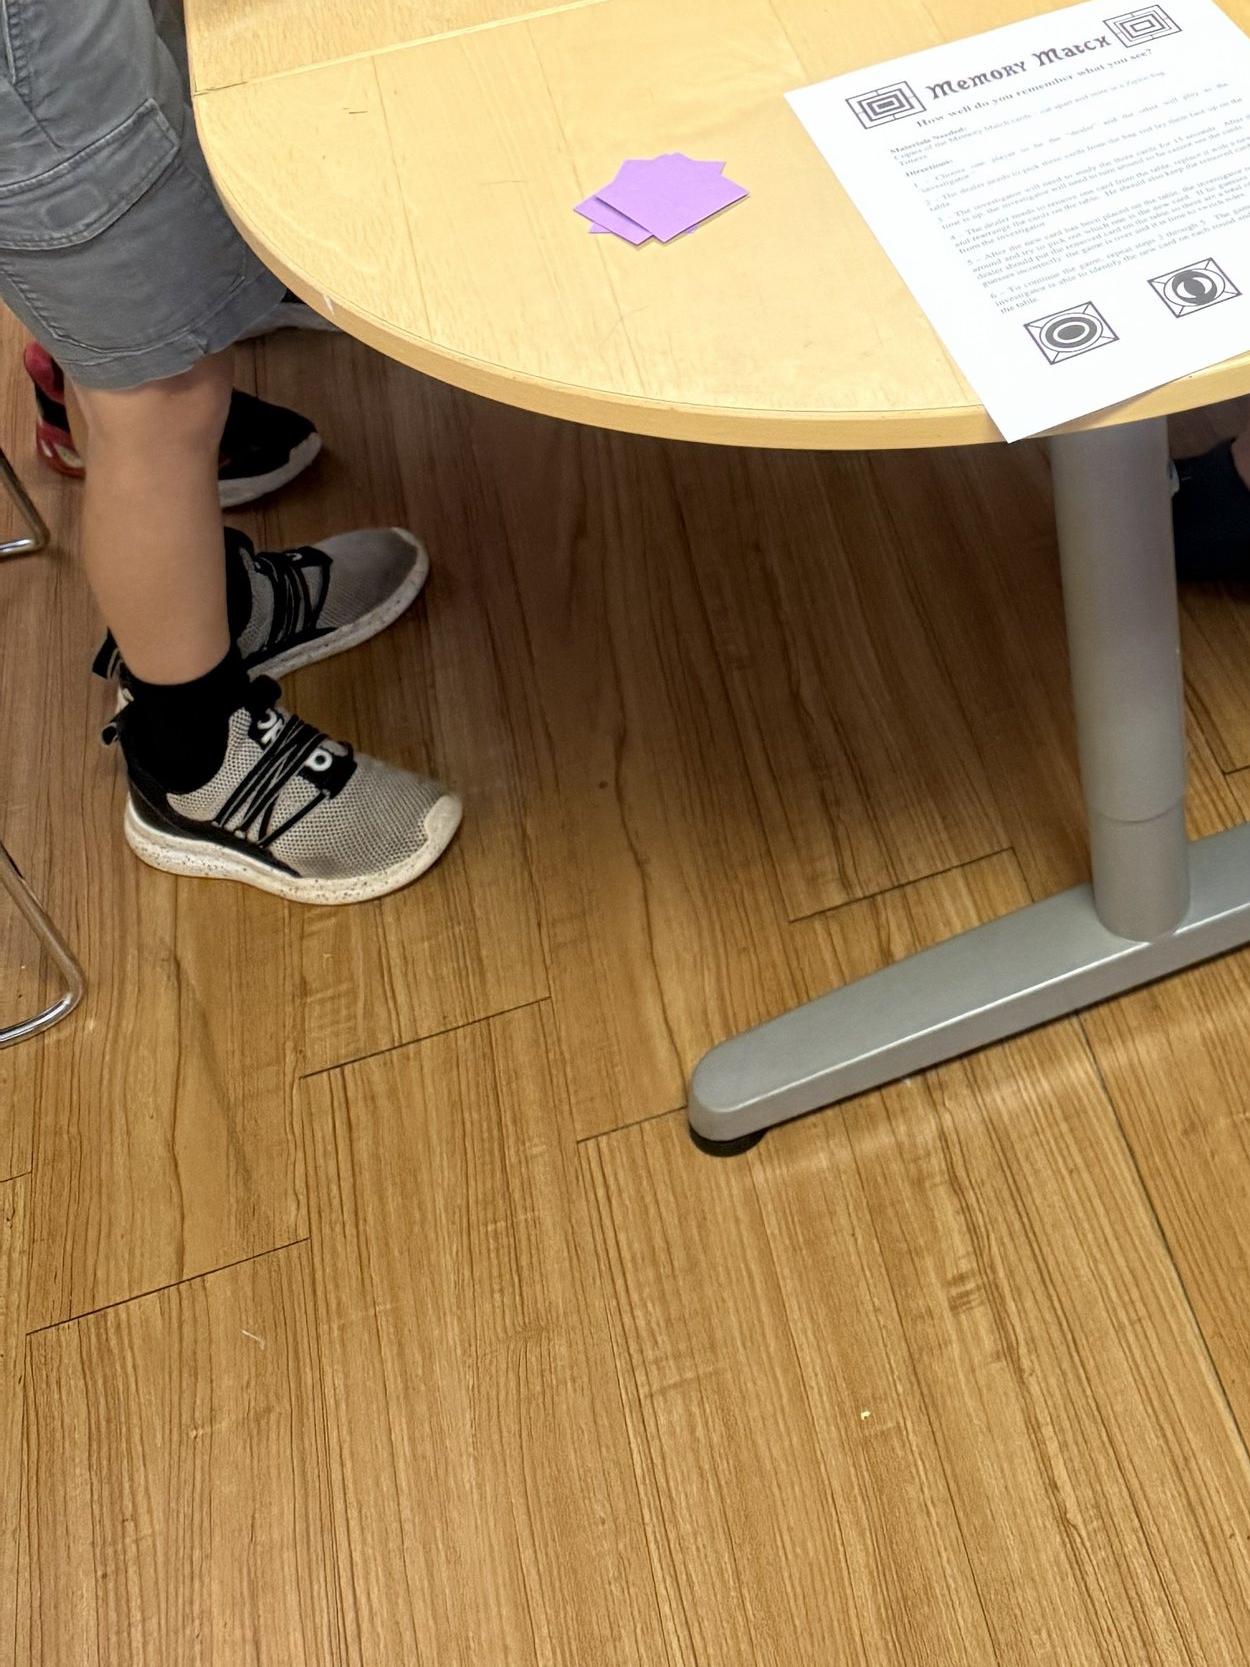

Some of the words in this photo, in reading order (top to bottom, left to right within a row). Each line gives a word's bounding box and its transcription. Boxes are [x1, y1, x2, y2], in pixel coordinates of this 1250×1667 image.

[916, 116, 943, 127] How
[948, 106, 972, 116] well
[992, 94, 1013, 103] you
[1016, 75, 1072, 96] remember
[1077, 65, 1105, 76] what
[1107, 58, 1128, 68] you
[1130, 49, 1152, 59] see?
